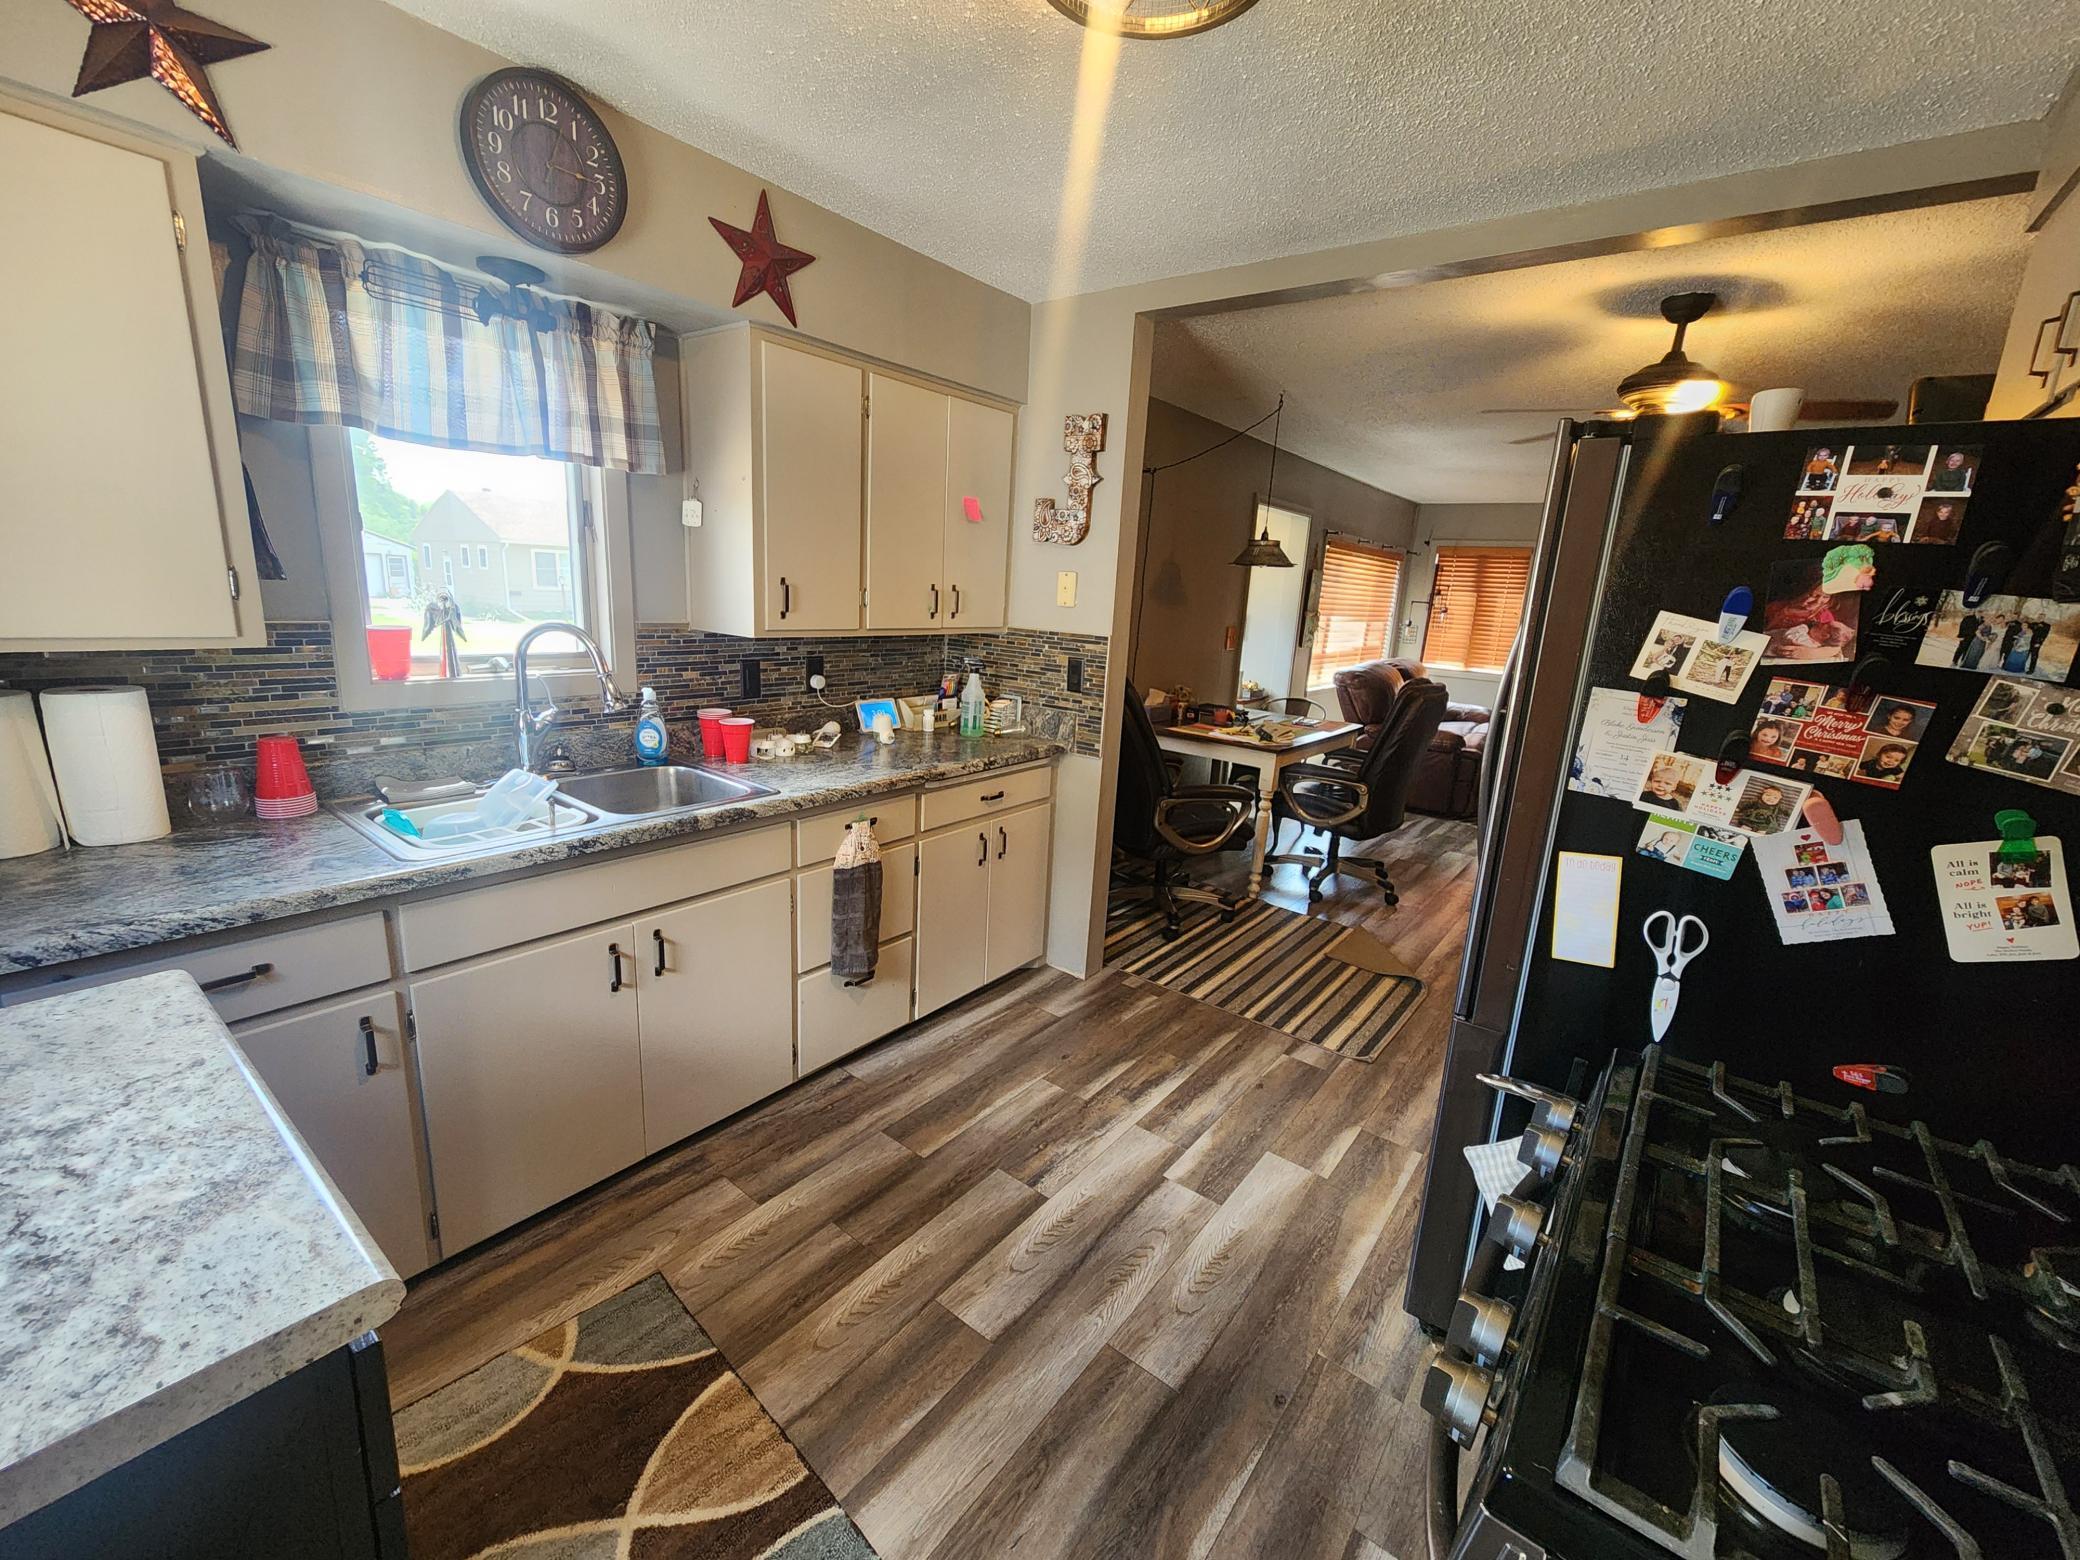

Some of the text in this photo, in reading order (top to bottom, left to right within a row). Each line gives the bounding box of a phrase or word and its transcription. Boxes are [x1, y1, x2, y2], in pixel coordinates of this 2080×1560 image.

[513, 94, 527, 119] 11
[539, 98, 558, 124] 12
[492, 105, 513, 131] 10
[571, 120, 577, 141] 1
[487, 131, 502, 154] 9
[586, 146, 599, 168] 2
[497, 161, 512, 183] 8
[594, 174, 606, 195] 3
[519, 190, 533, 211] 7
[586, 196, 600, 216] 4
[545, 207, 559, 228] 6
[571, 209, 583, 228] 5
[1032, 413, 1109, 546] J
[1803, 725, 1866, 742] Christmas
[1814, 714, 1863, 733] Merry
[1693, 843, 1738, 862] CHEERS
[1946, 859, 1979, 869] All is
[1949, 867, 1980, 878] calm
[1955, 878, 1984, 889] NOPE
[1952, 909, 1993, 920] bright
[1954, 901, 1988, 911] All is
[1967, 920, 1992, 931] YUP!
